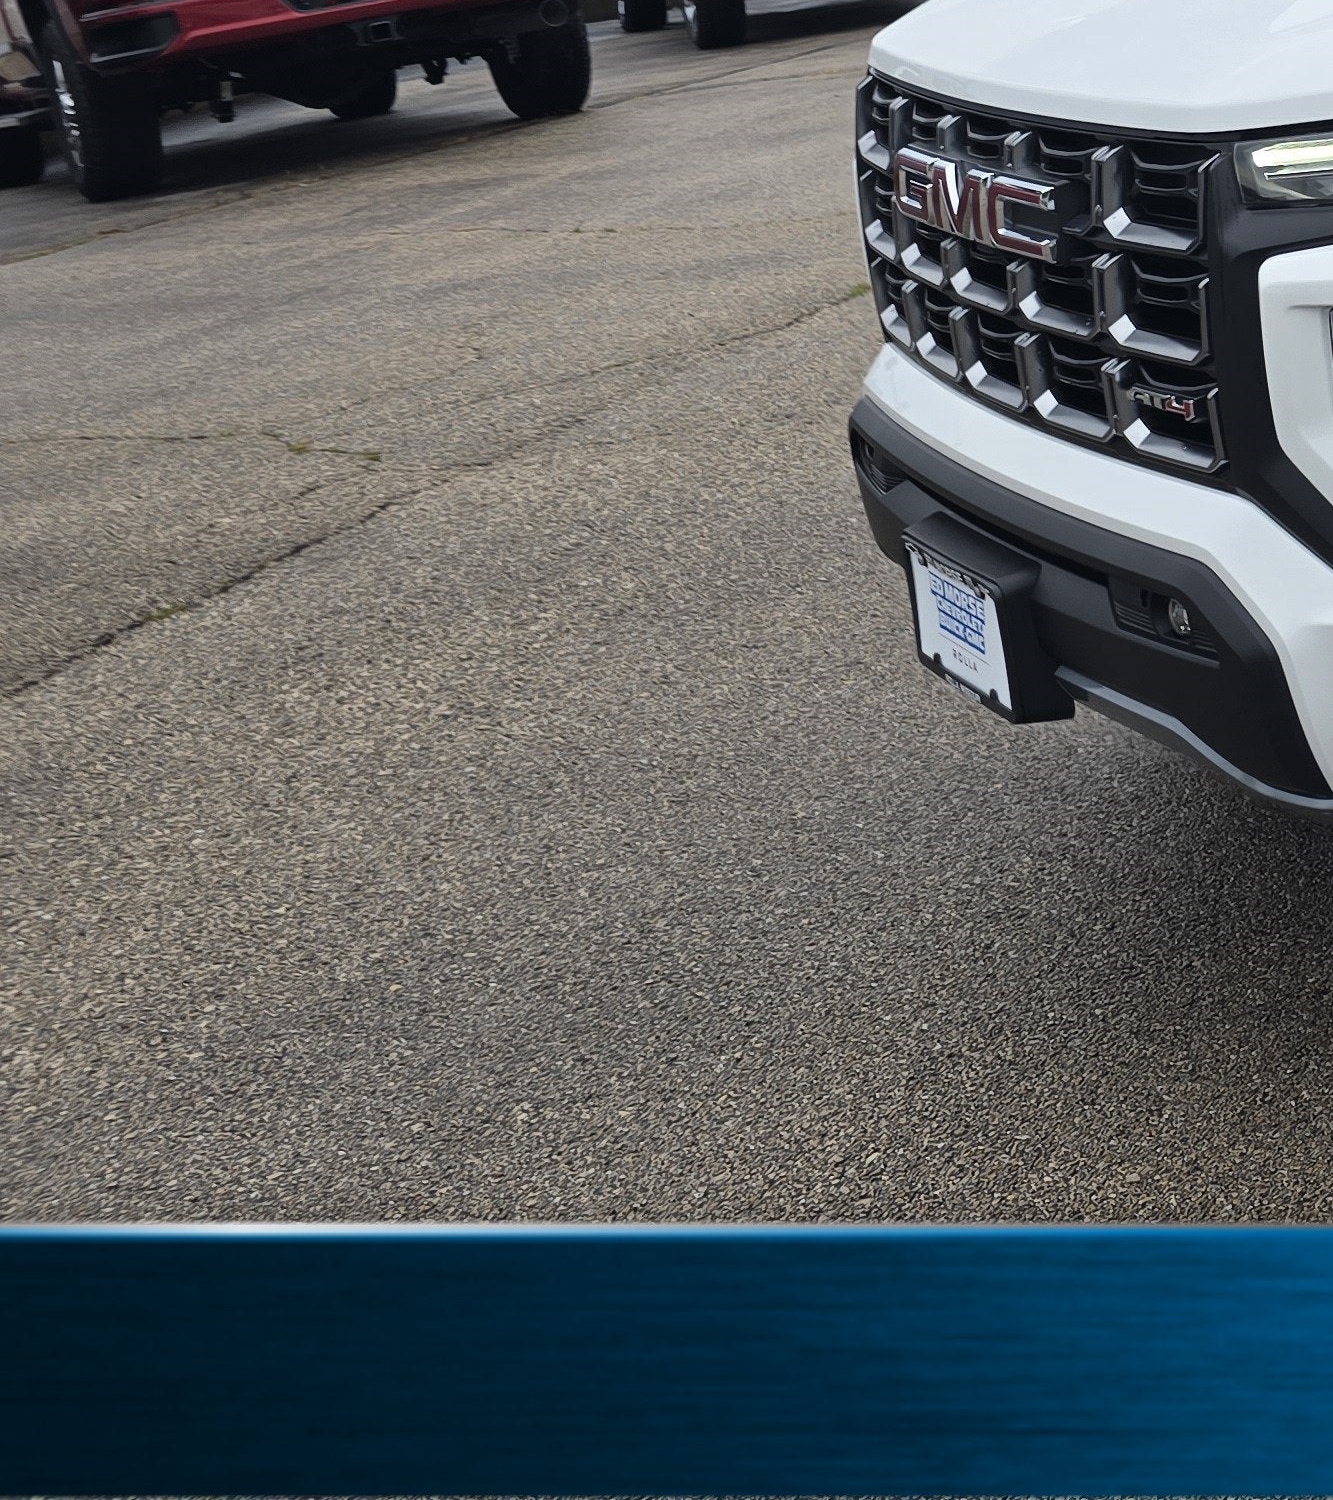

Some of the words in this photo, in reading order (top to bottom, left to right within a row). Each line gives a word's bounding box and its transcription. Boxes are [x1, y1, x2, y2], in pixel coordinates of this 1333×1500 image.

[895, 146, 1058, 264] GMC
[1127, 386, 1196, 422] AT4
[928, 571, 944, 598] ED
[942, 579, 986, 623] MORSE
[951, 646, 979, 674] ROLLA
